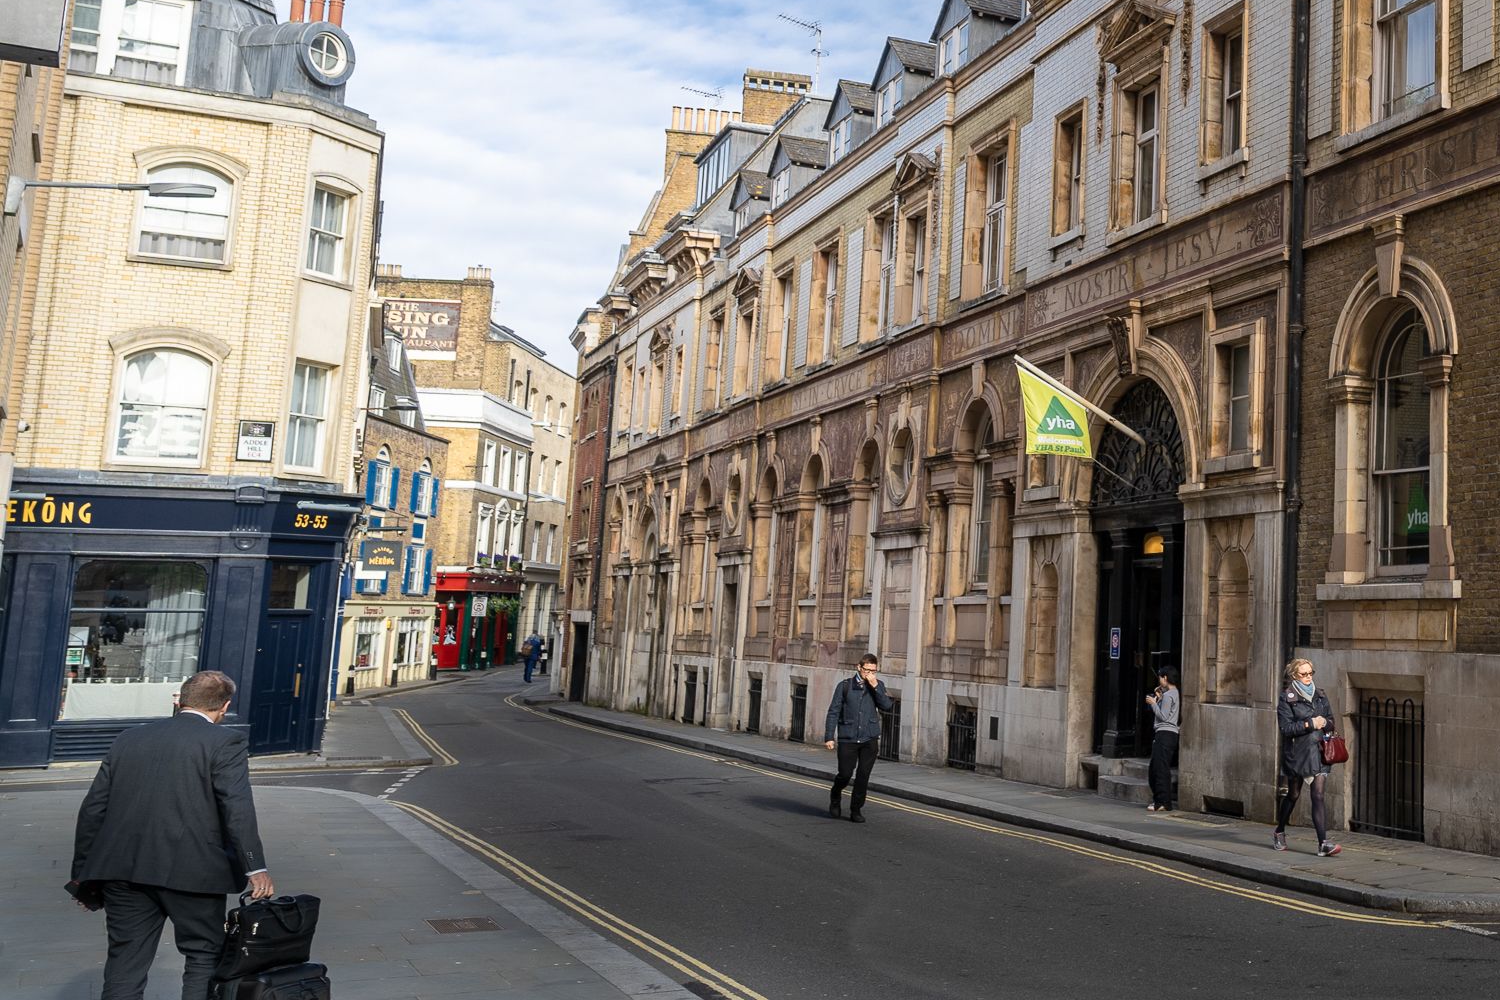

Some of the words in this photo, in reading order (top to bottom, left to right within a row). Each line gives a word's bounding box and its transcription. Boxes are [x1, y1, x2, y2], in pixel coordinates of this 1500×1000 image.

[1063, 257, 1137, 313] NOSTRI
[1160, 223, 1224, 281] JESV
[389, 302, 419, 312] THE
[387, 310, 450, 326] SING
[392, 326, 429, 339] UN
[1046, 415, 1075, 430] yha
[1035, 443, 1054, 451] YHA
[1055, 444, 1063, 452] St
[6, 496, 92, 524] EKŌNG
[294, 513, 329, 529] 53-55
[1407, 508, 1429, 530] yha
